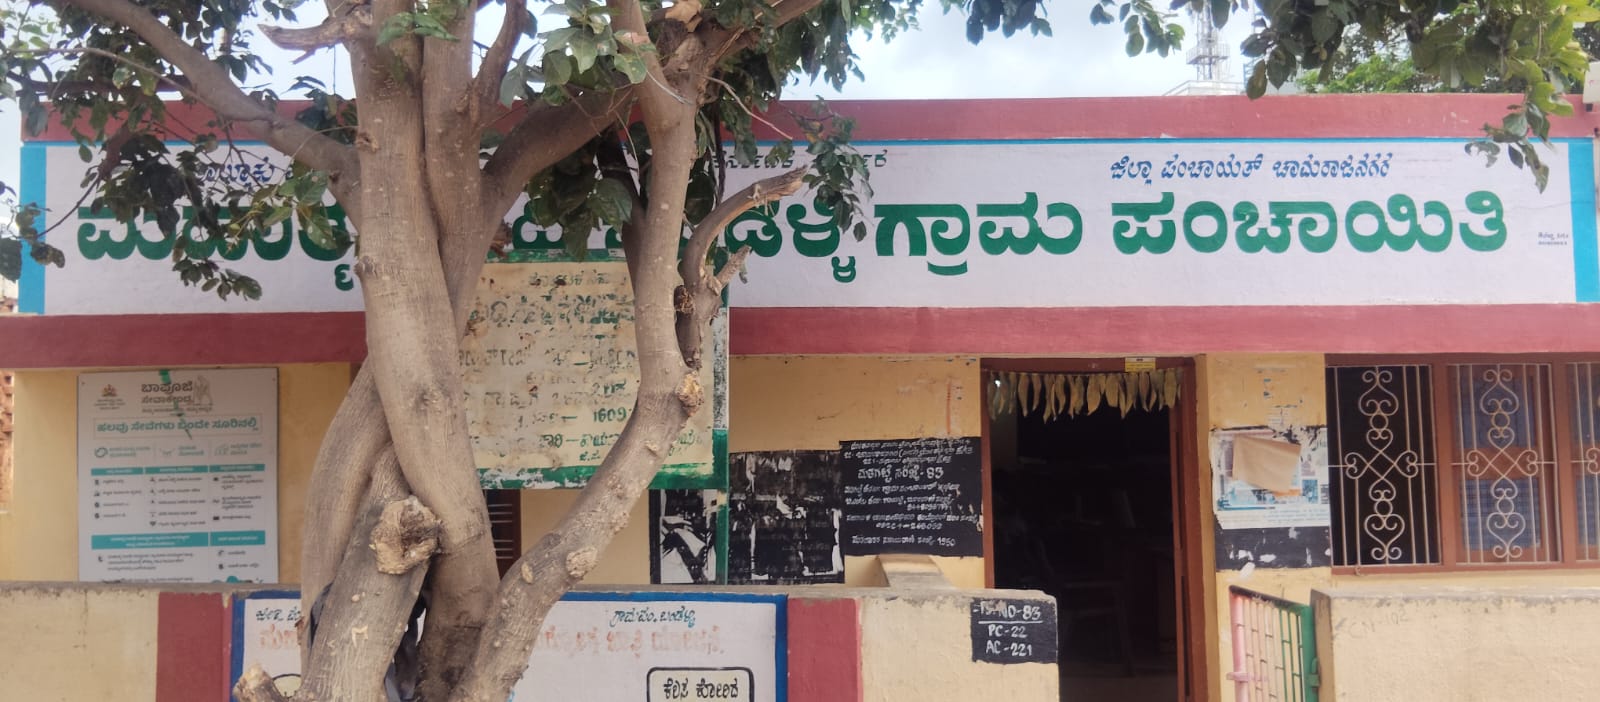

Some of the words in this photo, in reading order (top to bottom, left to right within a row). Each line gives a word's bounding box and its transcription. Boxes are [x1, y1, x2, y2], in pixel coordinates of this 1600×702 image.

[1110, 155, 1153, 184] ಜಿಲ್ಲಾ
[1161, 153, 1264, 179] ಪಂಚಾಯತ್
[1271, 152, 1393, 179] ಚಾಮರಾಜನಗರ
[874, 192, 1083, 276] ಗ್ರಾಮ
[1112, 191, 1508, 255] ಪಂಚಾಯಿತಿ
[988, 624, 1028, 638] PC-22
[986, 640, 1033, 656] AC-221
[663, 678, 689, 700] ಕೆಲಸ
